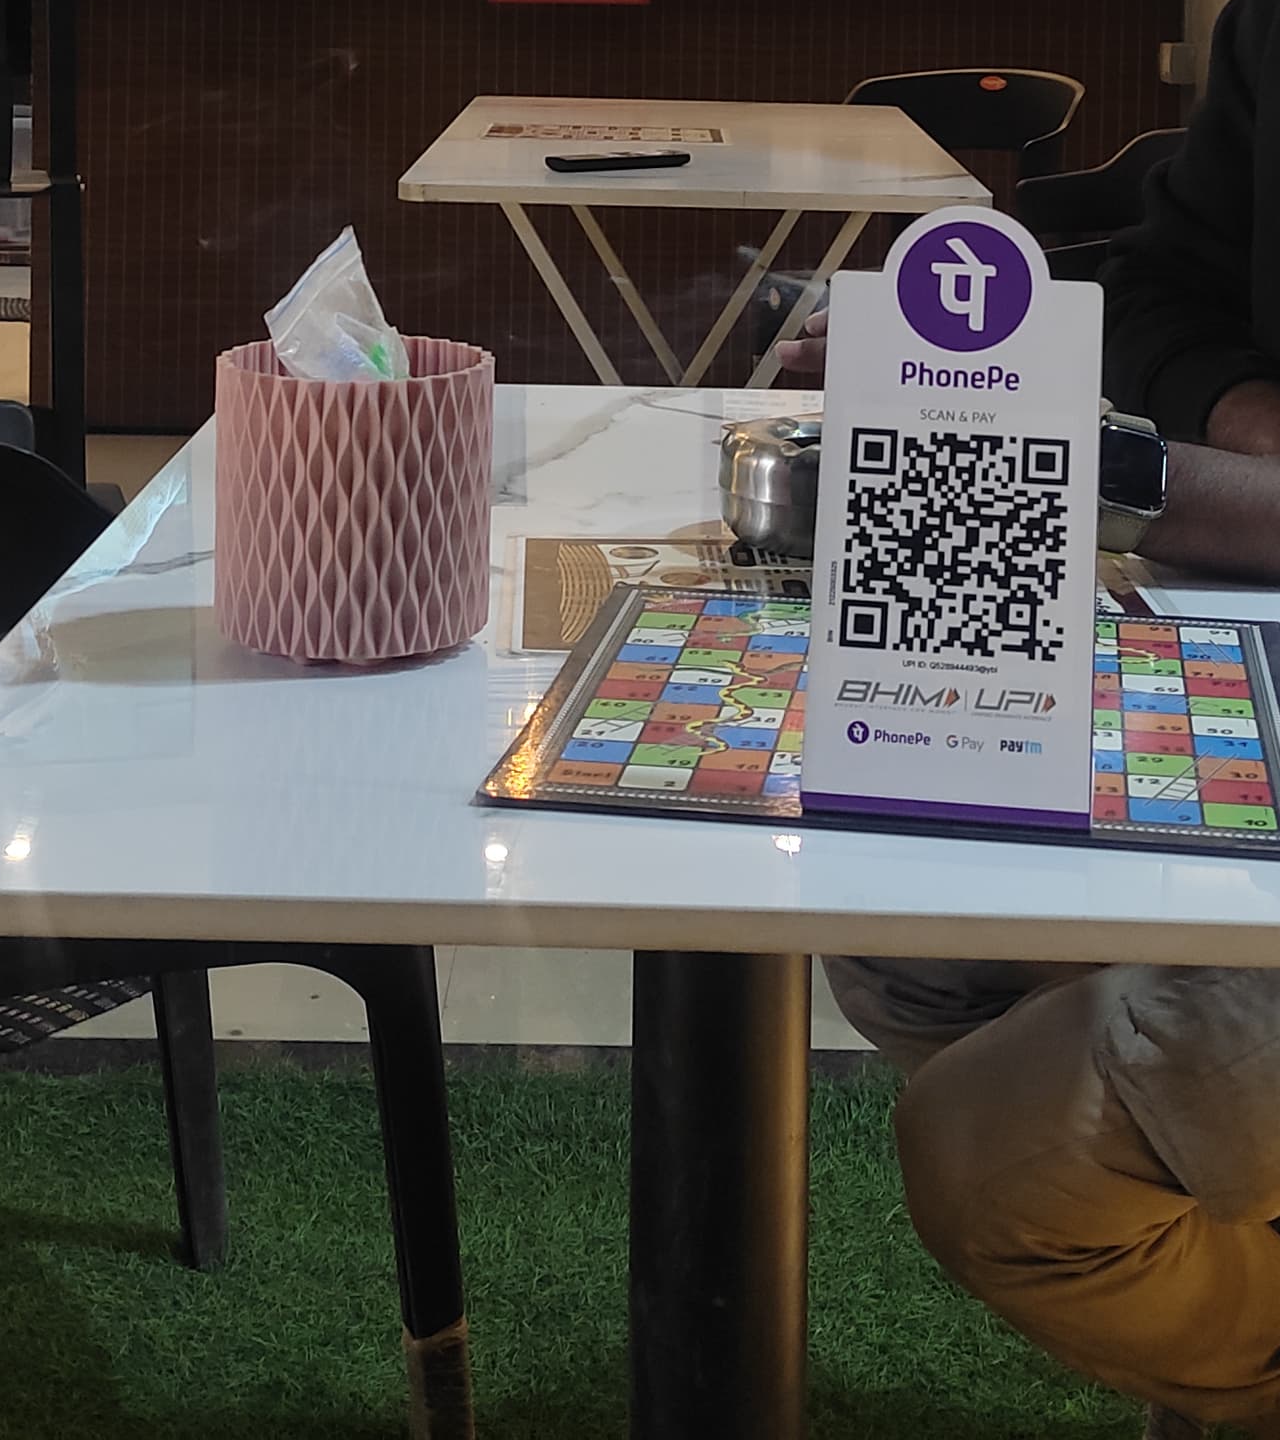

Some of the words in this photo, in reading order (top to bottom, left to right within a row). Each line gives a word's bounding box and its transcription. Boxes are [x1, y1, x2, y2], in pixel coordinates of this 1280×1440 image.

[930, 237, 997, 332] पे
[900, 360, 1021, 392] PhonePe
[920, 408, 956, 422] SCAN
[959, 410, 968, 423] &
[972, 411, 997, 424] PAY
[836, 679, 947, 709] BHIM
[974, 688, 1044, 714] UPI
[873, 728, 932, 747] PhonePe
[1206, 727, 1234, 735] 50
[961, 736, 985, 752] Pay
[1135, 755, 1164, 764] 29
[1133, 777, 1161, 785] 12
[1177, 813, 1192, 822] 9
[1243, 819, 1268, 828] 10
